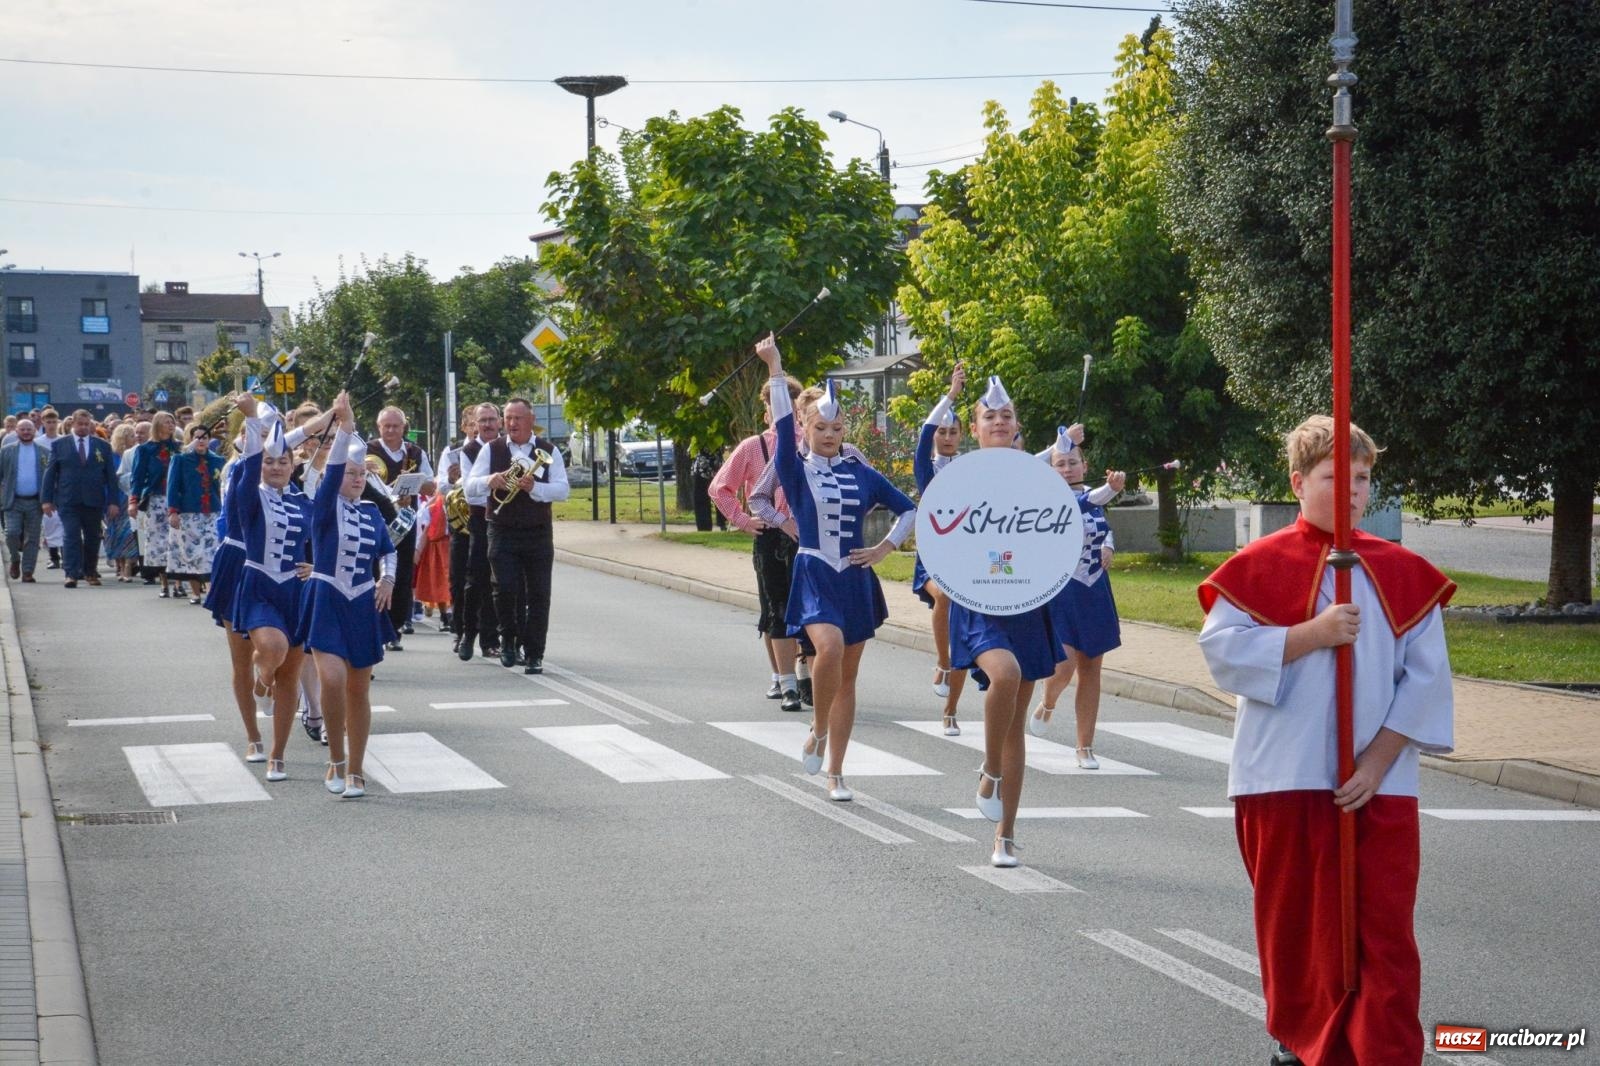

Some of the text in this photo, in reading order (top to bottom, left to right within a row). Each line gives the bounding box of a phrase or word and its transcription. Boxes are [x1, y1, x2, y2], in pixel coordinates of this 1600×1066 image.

[932, 574, 955, 594] GMINNY
[954, 592, 982, 609] OŚRODEK
[984, 603, 1013, 612] KULTURY
[1021, 573, 1070, 608] KRZYŻANOWICACH
